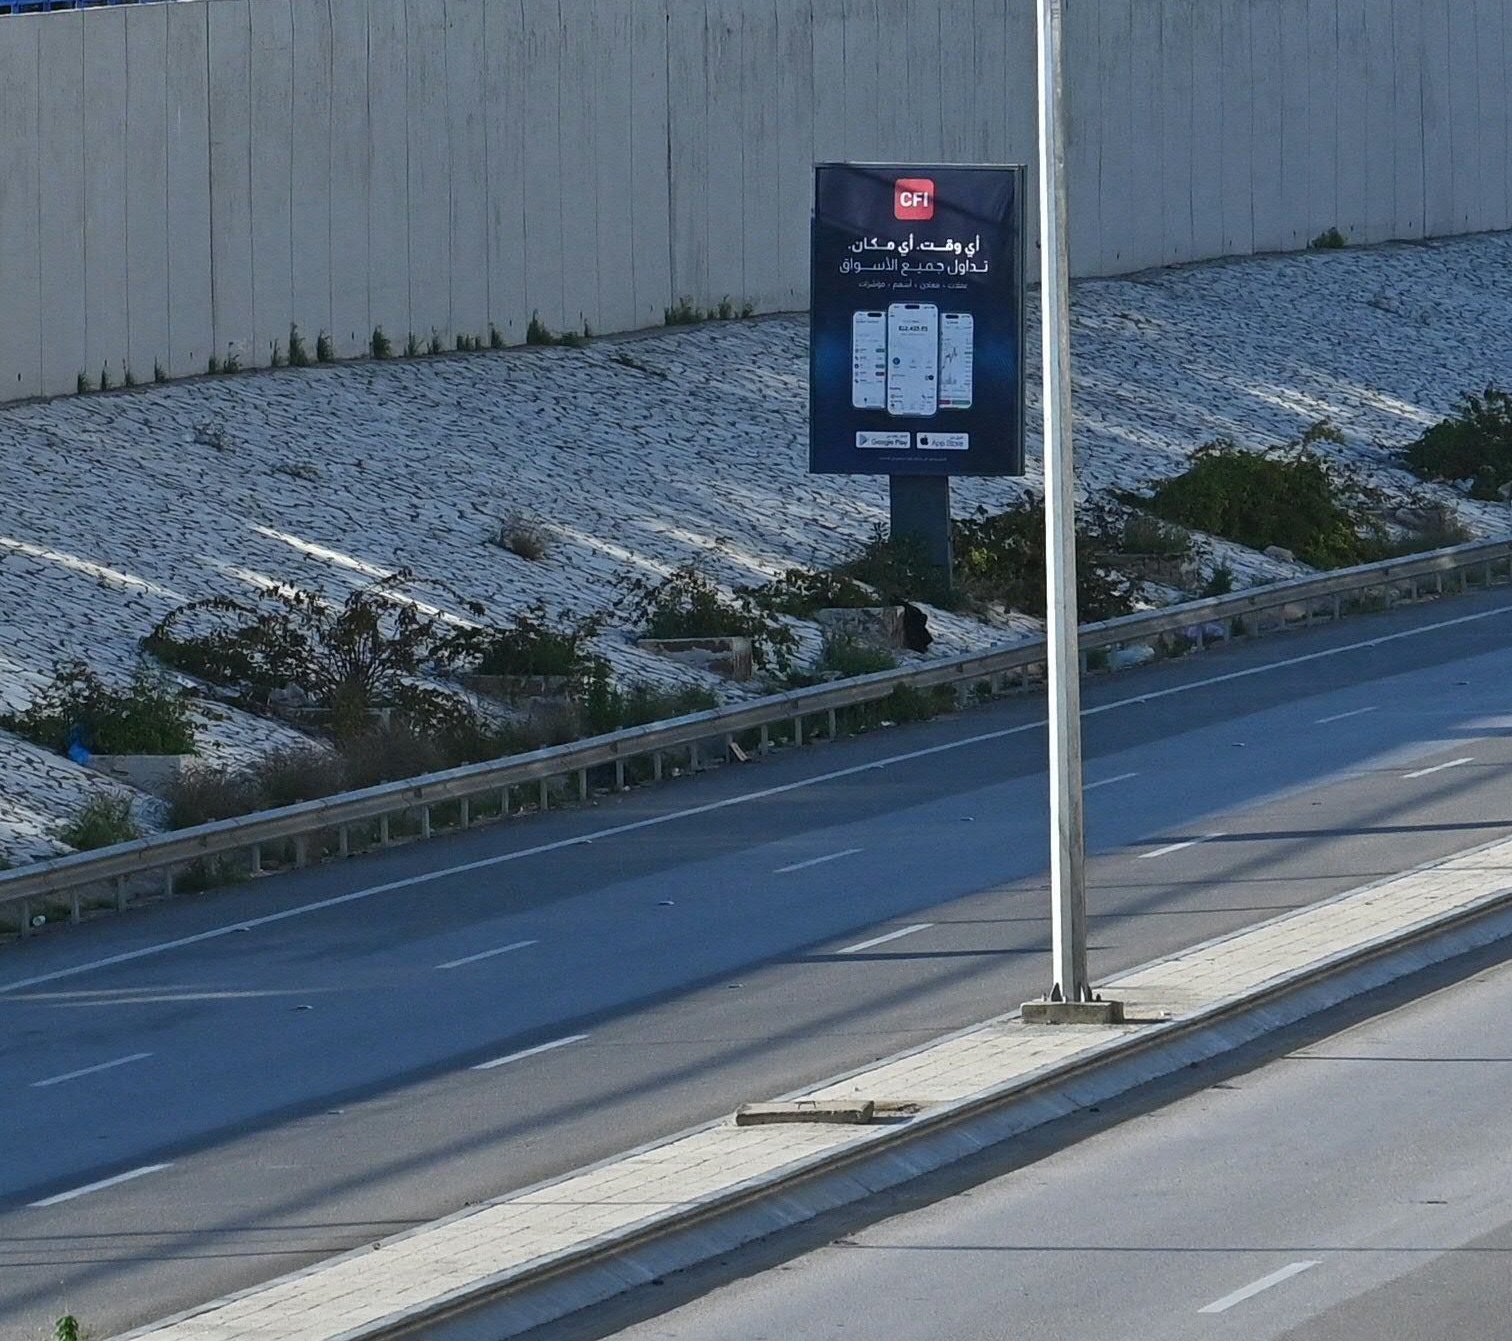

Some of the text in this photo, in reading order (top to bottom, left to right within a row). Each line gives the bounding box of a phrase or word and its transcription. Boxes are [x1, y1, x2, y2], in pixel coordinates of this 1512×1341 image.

[900, 191, 929, 208] CFI
[897, 233, 914, 256] أي
[965, 234, 980, 258] أي
[839, 257, 989, 276] تداول جميع الأسواق
